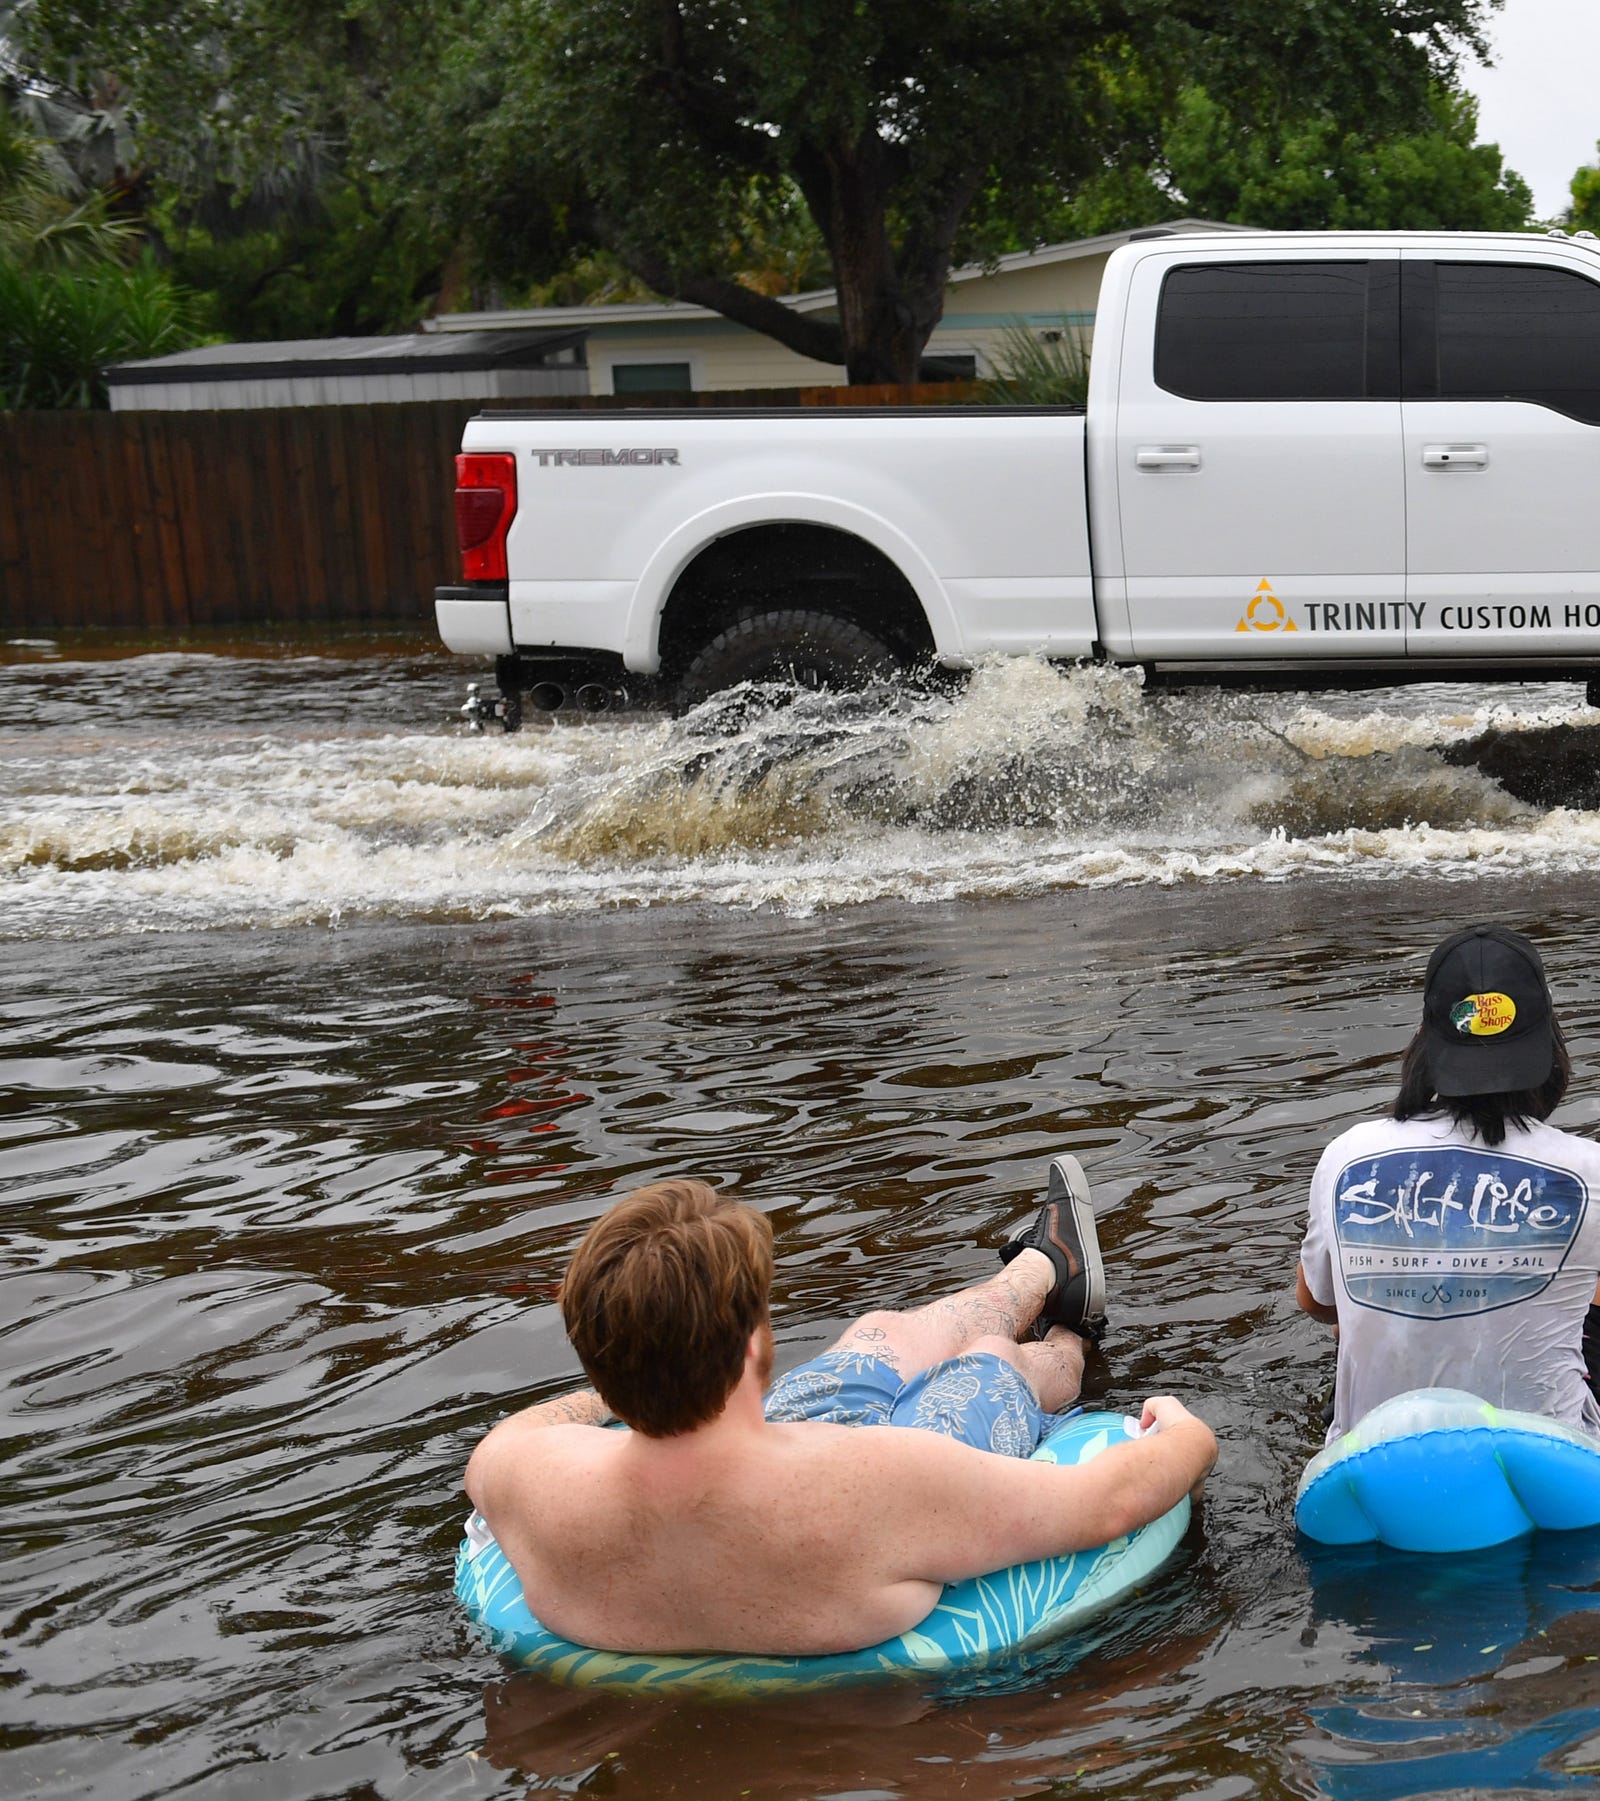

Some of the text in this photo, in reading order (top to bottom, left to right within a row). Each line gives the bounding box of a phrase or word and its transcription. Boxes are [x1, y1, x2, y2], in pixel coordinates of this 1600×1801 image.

[531, 449, 681, 467] TREMOR
[1304, 602, 1426, 631] TRINITY
[1440, 605, 1551, 630] CUSTOM
[1477, 995, 1502, 1006] Bass
[1479, 1007, 1498, 1018] Pro
[1480, 1015, 1512, 1028] Shops
[1349, 1256, 1545, 1268] FISH SURF DIVE SAIL
[1386, 1288, 1487, 1298] SINCE 2003
